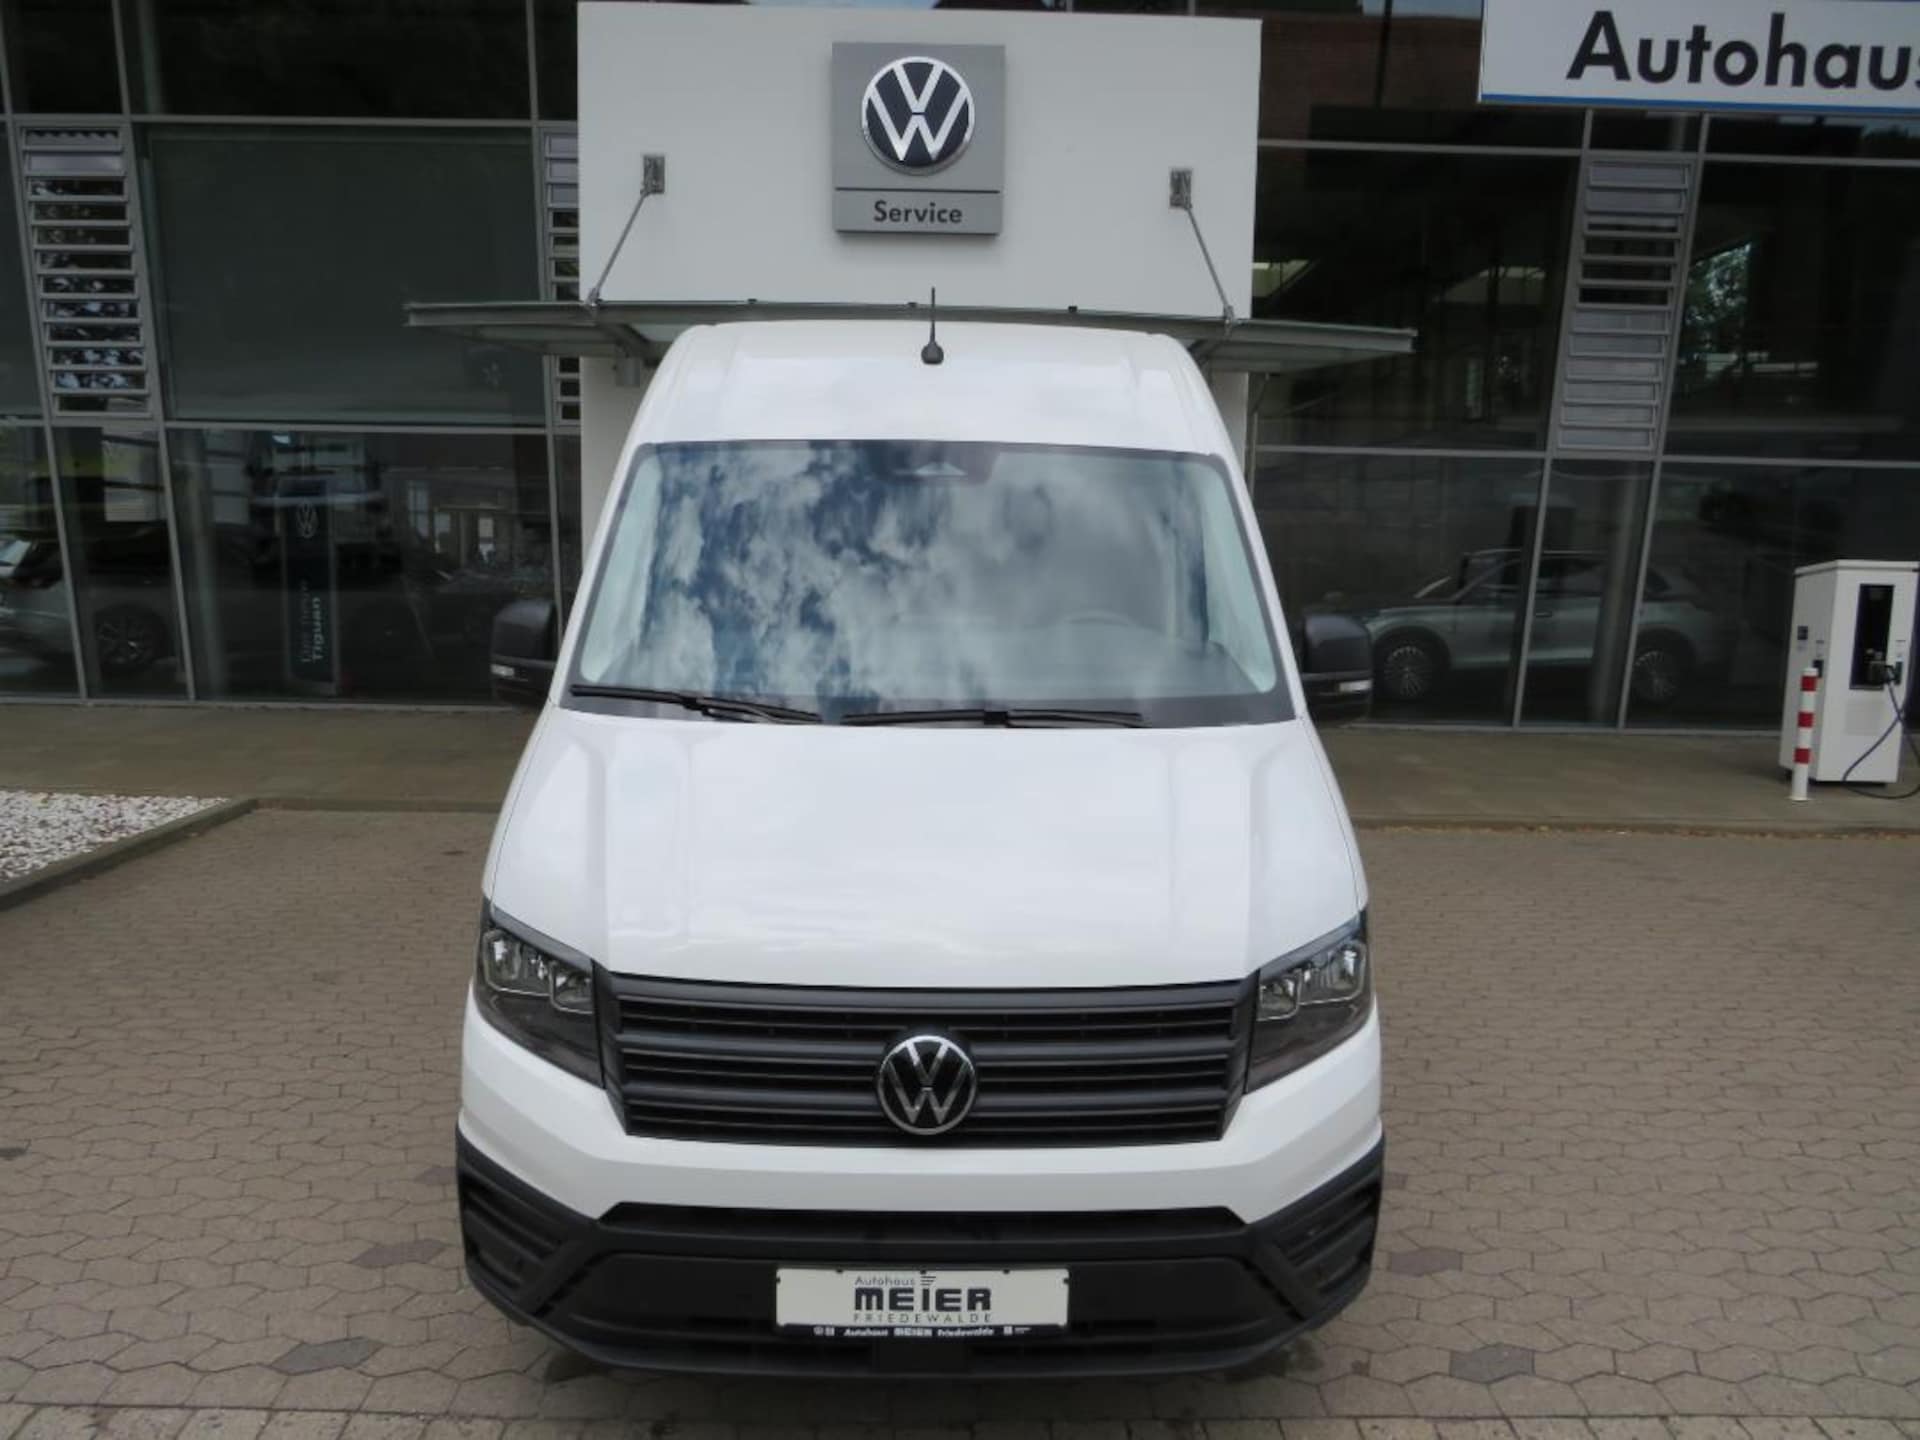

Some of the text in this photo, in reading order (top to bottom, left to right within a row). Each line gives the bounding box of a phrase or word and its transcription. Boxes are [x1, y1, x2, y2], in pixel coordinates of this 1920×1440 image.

[1566, 10, 1920, 90] Autohau
[865, 59, 972, 164] VW
[873, 200, 963, 223] Service
[311, 597, 324, 662] Tiguan
[882, 1037, 973, 1127] VW
[854, 1275, 916, 1287] Autohaus
[854, 1287, 992, 1312] MEIER
[853, 1313, 993, 1324] FRIEDEWALDE
